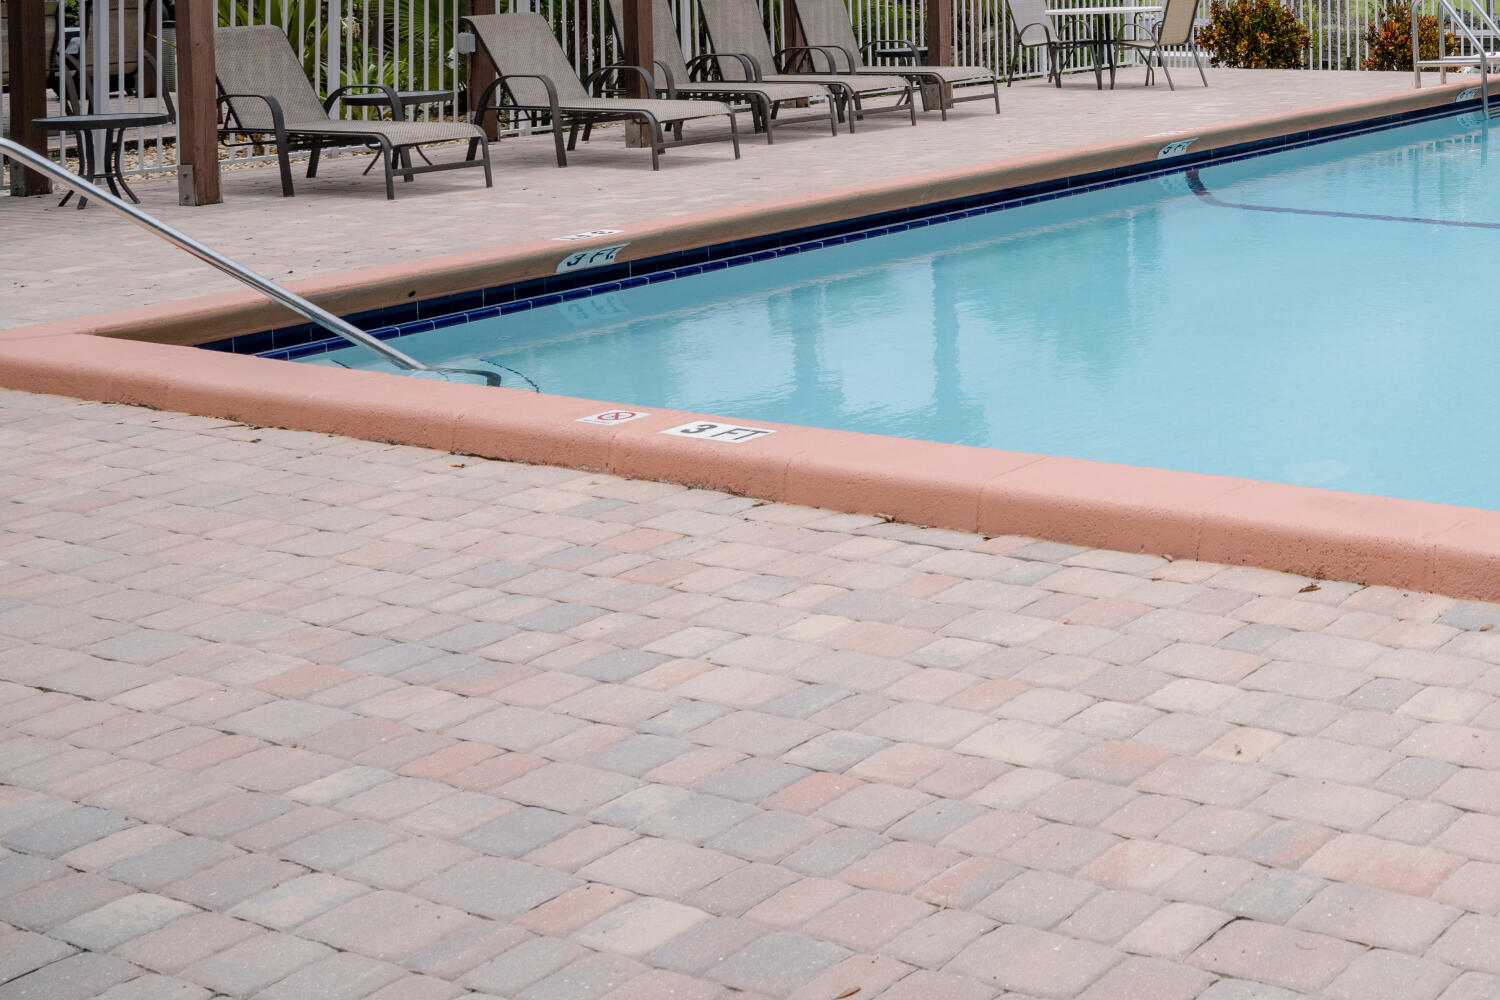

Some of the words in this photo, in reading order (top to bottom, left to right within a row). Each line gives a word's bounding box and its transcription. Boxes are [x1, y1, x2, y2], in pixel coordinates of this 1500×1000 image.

[566, 252, 588, 267] 3
[679, 423, 719, 434] 3
[708, 427, 771, 441] FT
